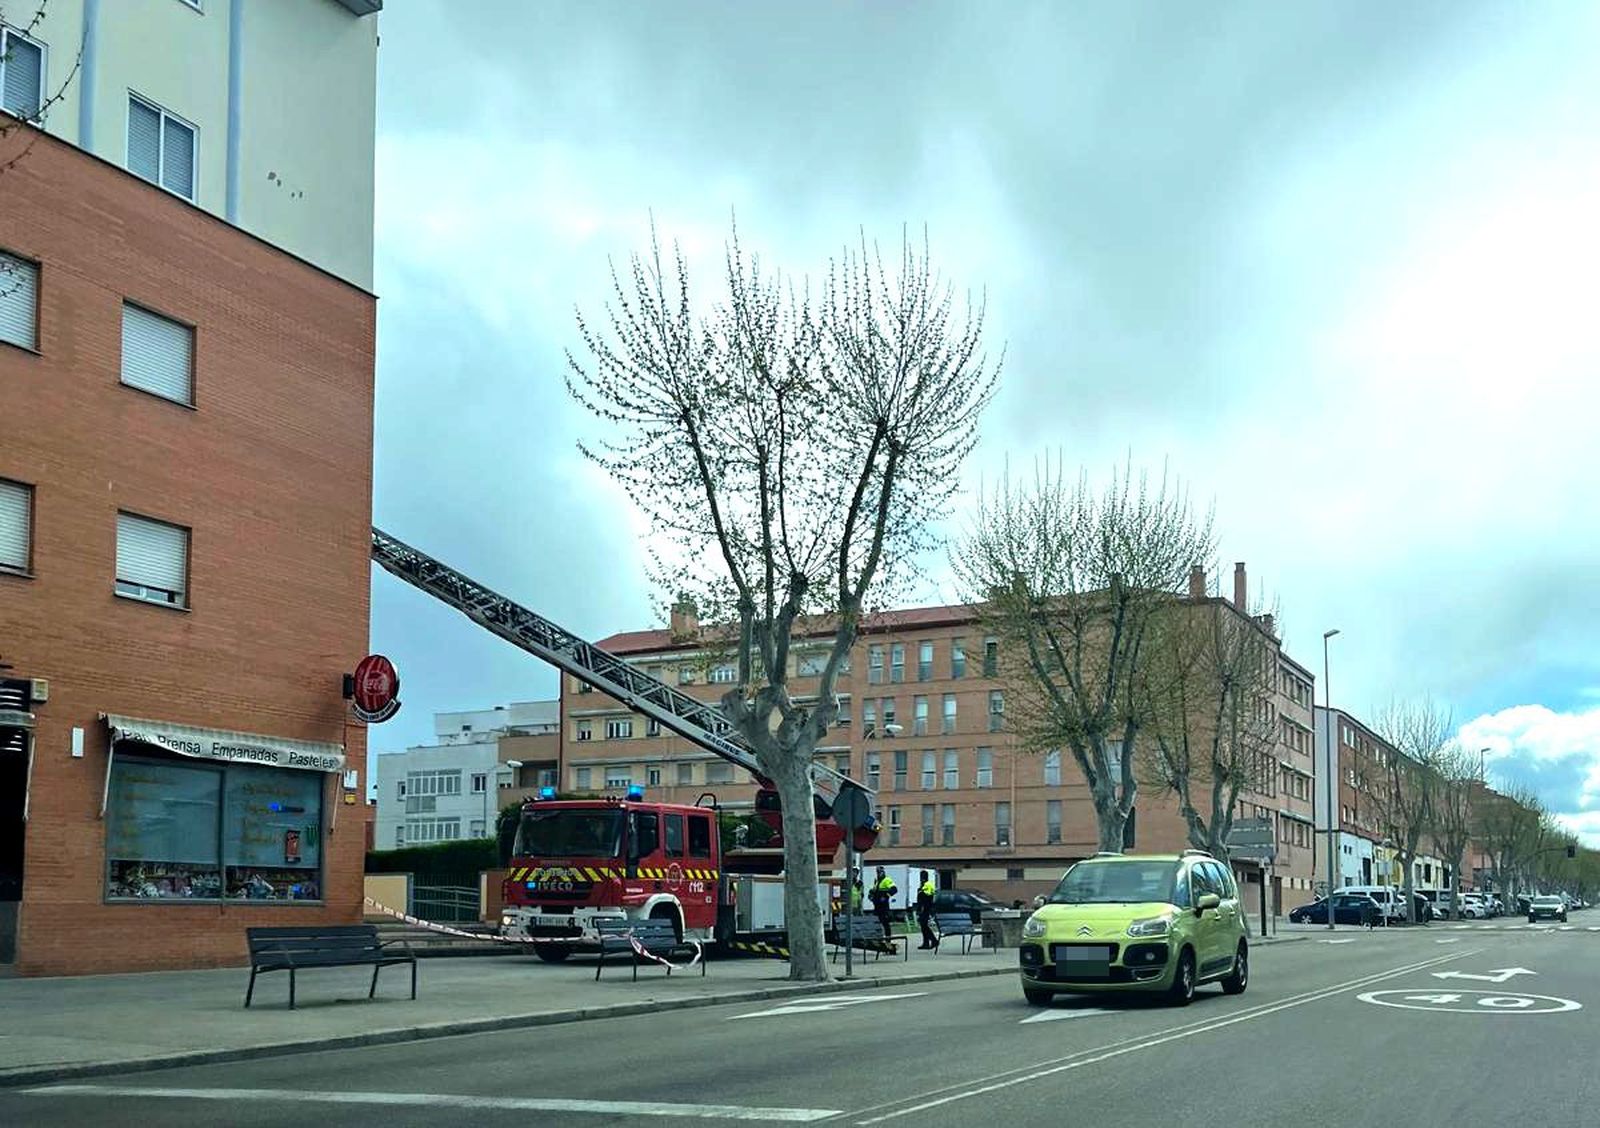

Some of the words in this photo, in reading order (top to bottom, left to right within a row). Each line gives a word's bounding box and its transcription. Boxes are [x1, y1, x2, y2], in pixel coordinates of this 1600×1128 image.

[157, 734, 201, 754] Prensa
[212, 742, 279, 763] Empanadas
[288, 751, 336, 769] Pasteles
[537, 881, 574, 892] IVECO
